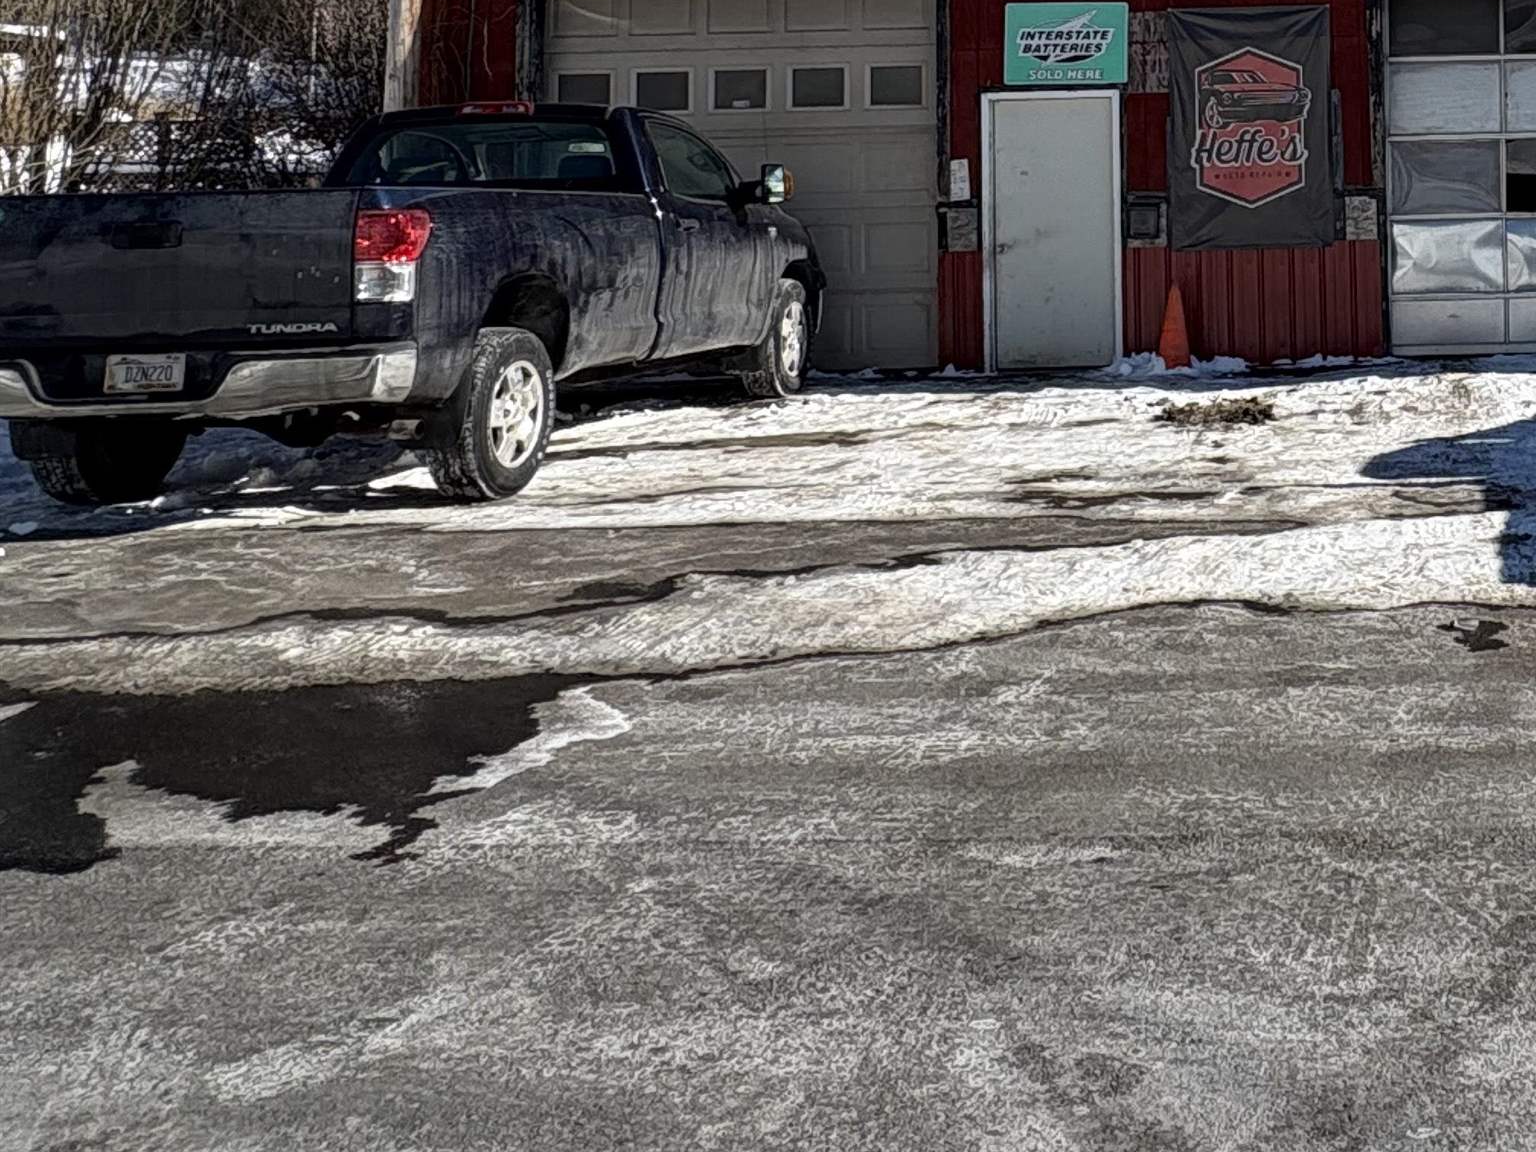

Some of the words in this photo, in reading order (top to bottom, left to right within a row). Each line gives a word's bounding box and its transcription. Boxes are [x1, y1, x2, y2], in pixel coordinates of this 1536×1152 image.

[1020, 30, 1110, 41] INTERSTATE
[1022, 43, 1103, 54] BATTERIES
[1029, 69, 1063, 80] SOLD
[1067, 69, 1103, 80] HERE
[1192, 126, 1308, 166] Heffe's
[246, 322, 338, 335] TUNDRA
